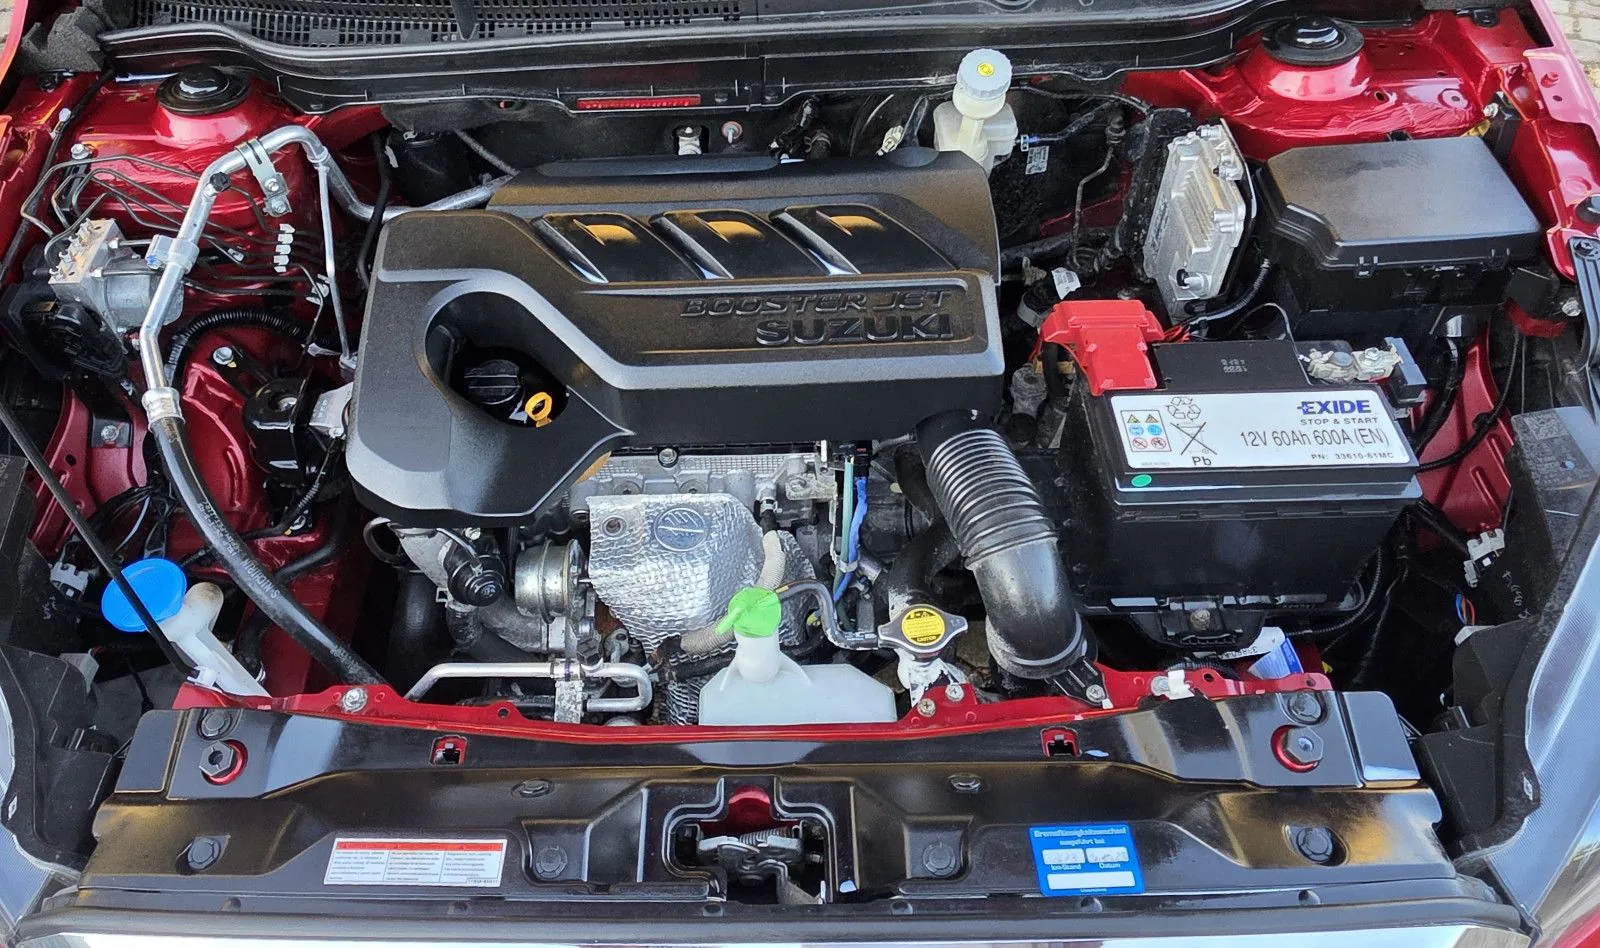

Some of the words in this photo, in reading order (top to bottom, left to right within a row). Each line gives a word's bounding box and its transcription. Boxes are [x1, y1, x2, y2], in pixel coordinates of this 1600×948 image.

[756, 313, 954, 346] SUZUKI
[1298, 399, 1372, 415] EXIDE
[1300, 418, 1329, 426] STOP
[1333, 417, 1341, 425] &
[1344, 416, 1379, 425] START
[1240, 431, 1268, 447] 12V
[1272, 430, 1312, 447] 60Ah
[1313, 428, 1354, 446] 600A
[1355, 428, 1389, 447] (EN)
[1191, 455, 1212, 467] Pb
